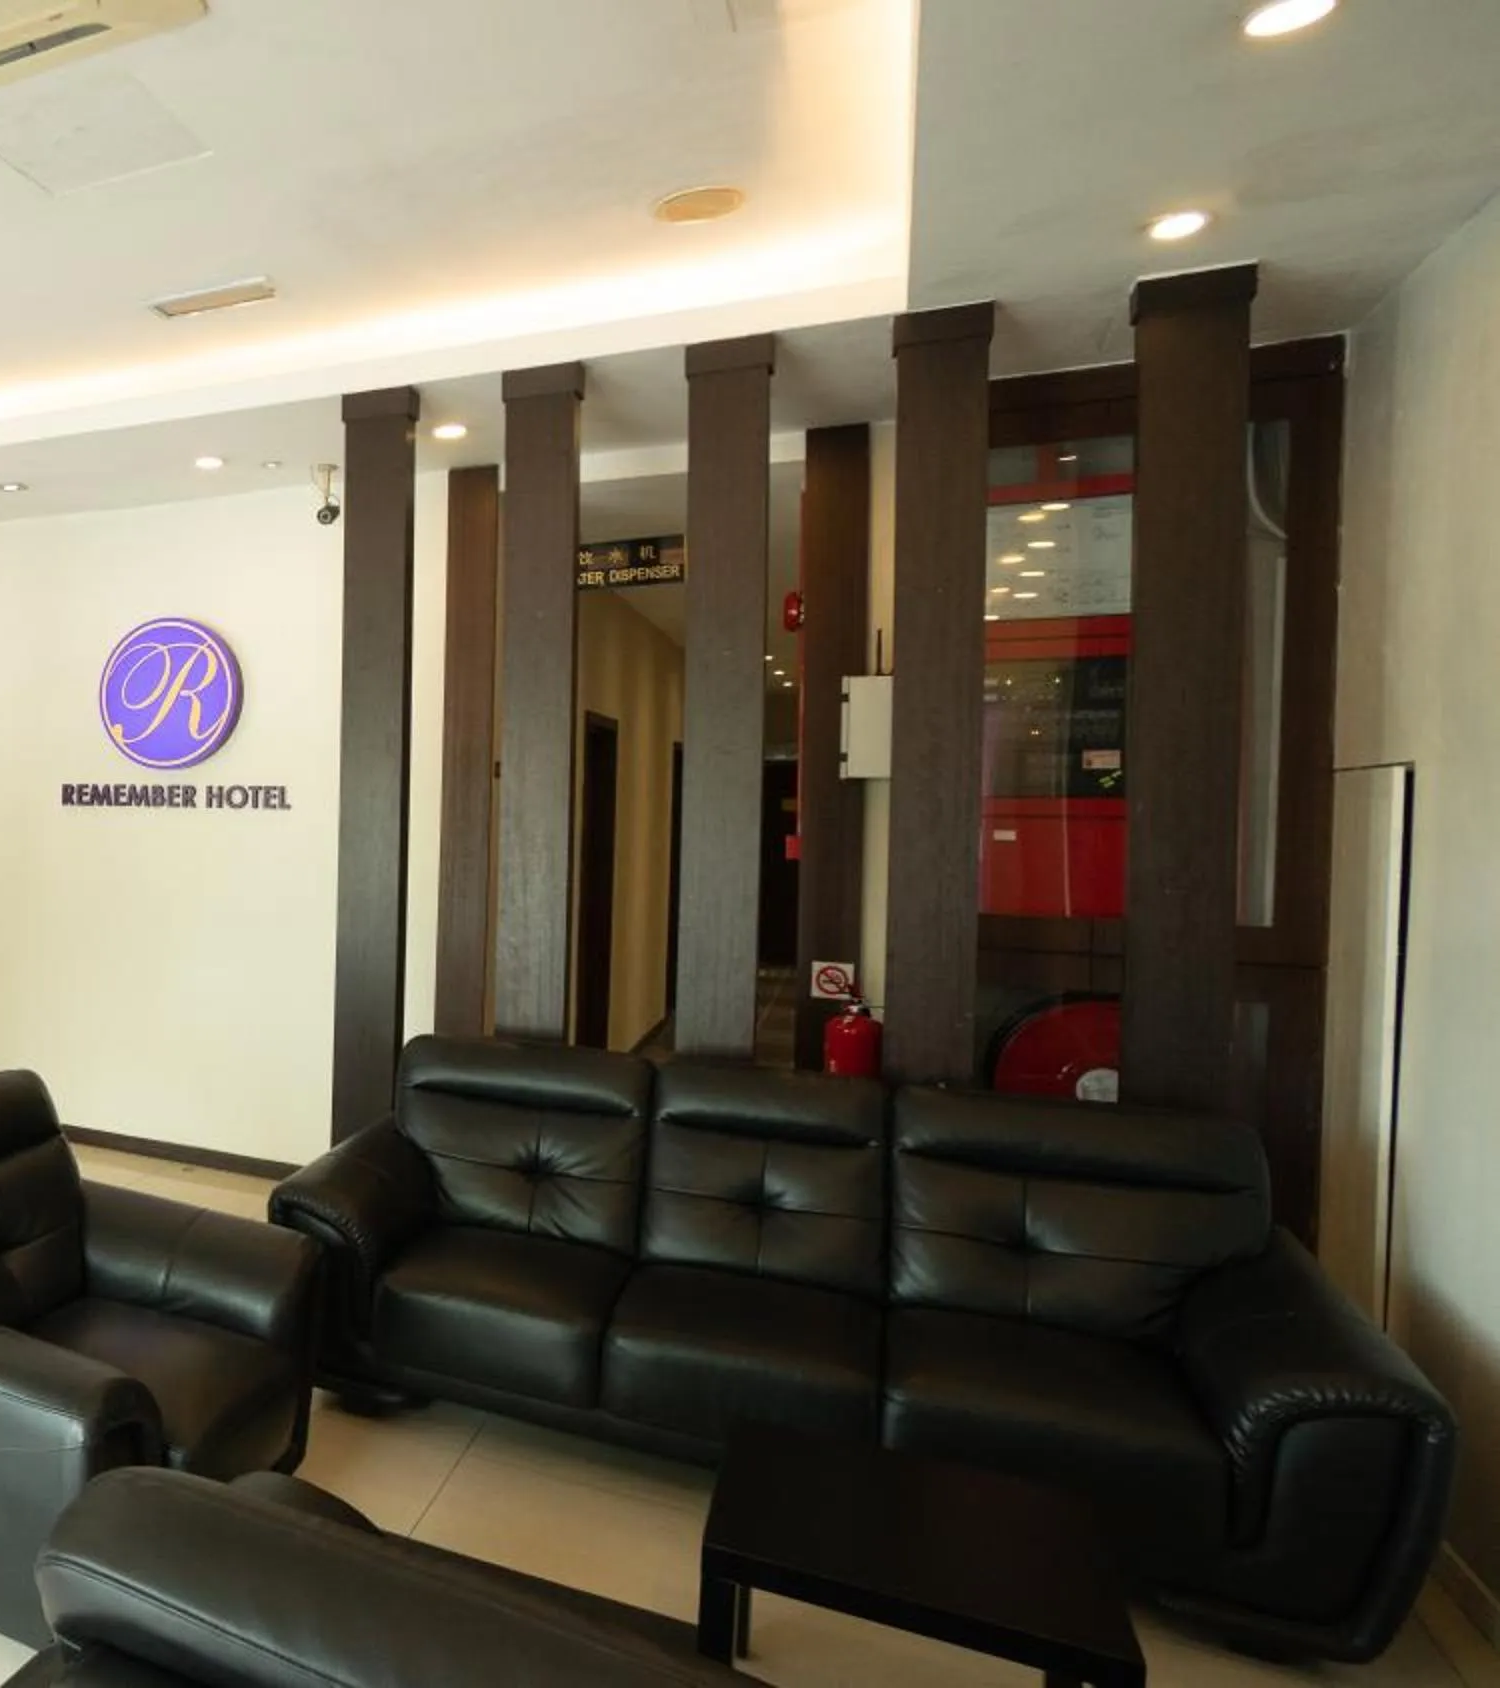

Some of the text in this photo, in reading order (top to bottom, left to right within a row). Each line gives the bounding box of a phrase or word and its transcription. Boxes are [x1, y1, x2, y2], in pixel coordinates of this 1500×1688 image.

[578, 564, 680, 585] TER DISPENSER
[105, 641, 231, 744] R
[61, 783, 291, 810] REMEMBER HOTEL
